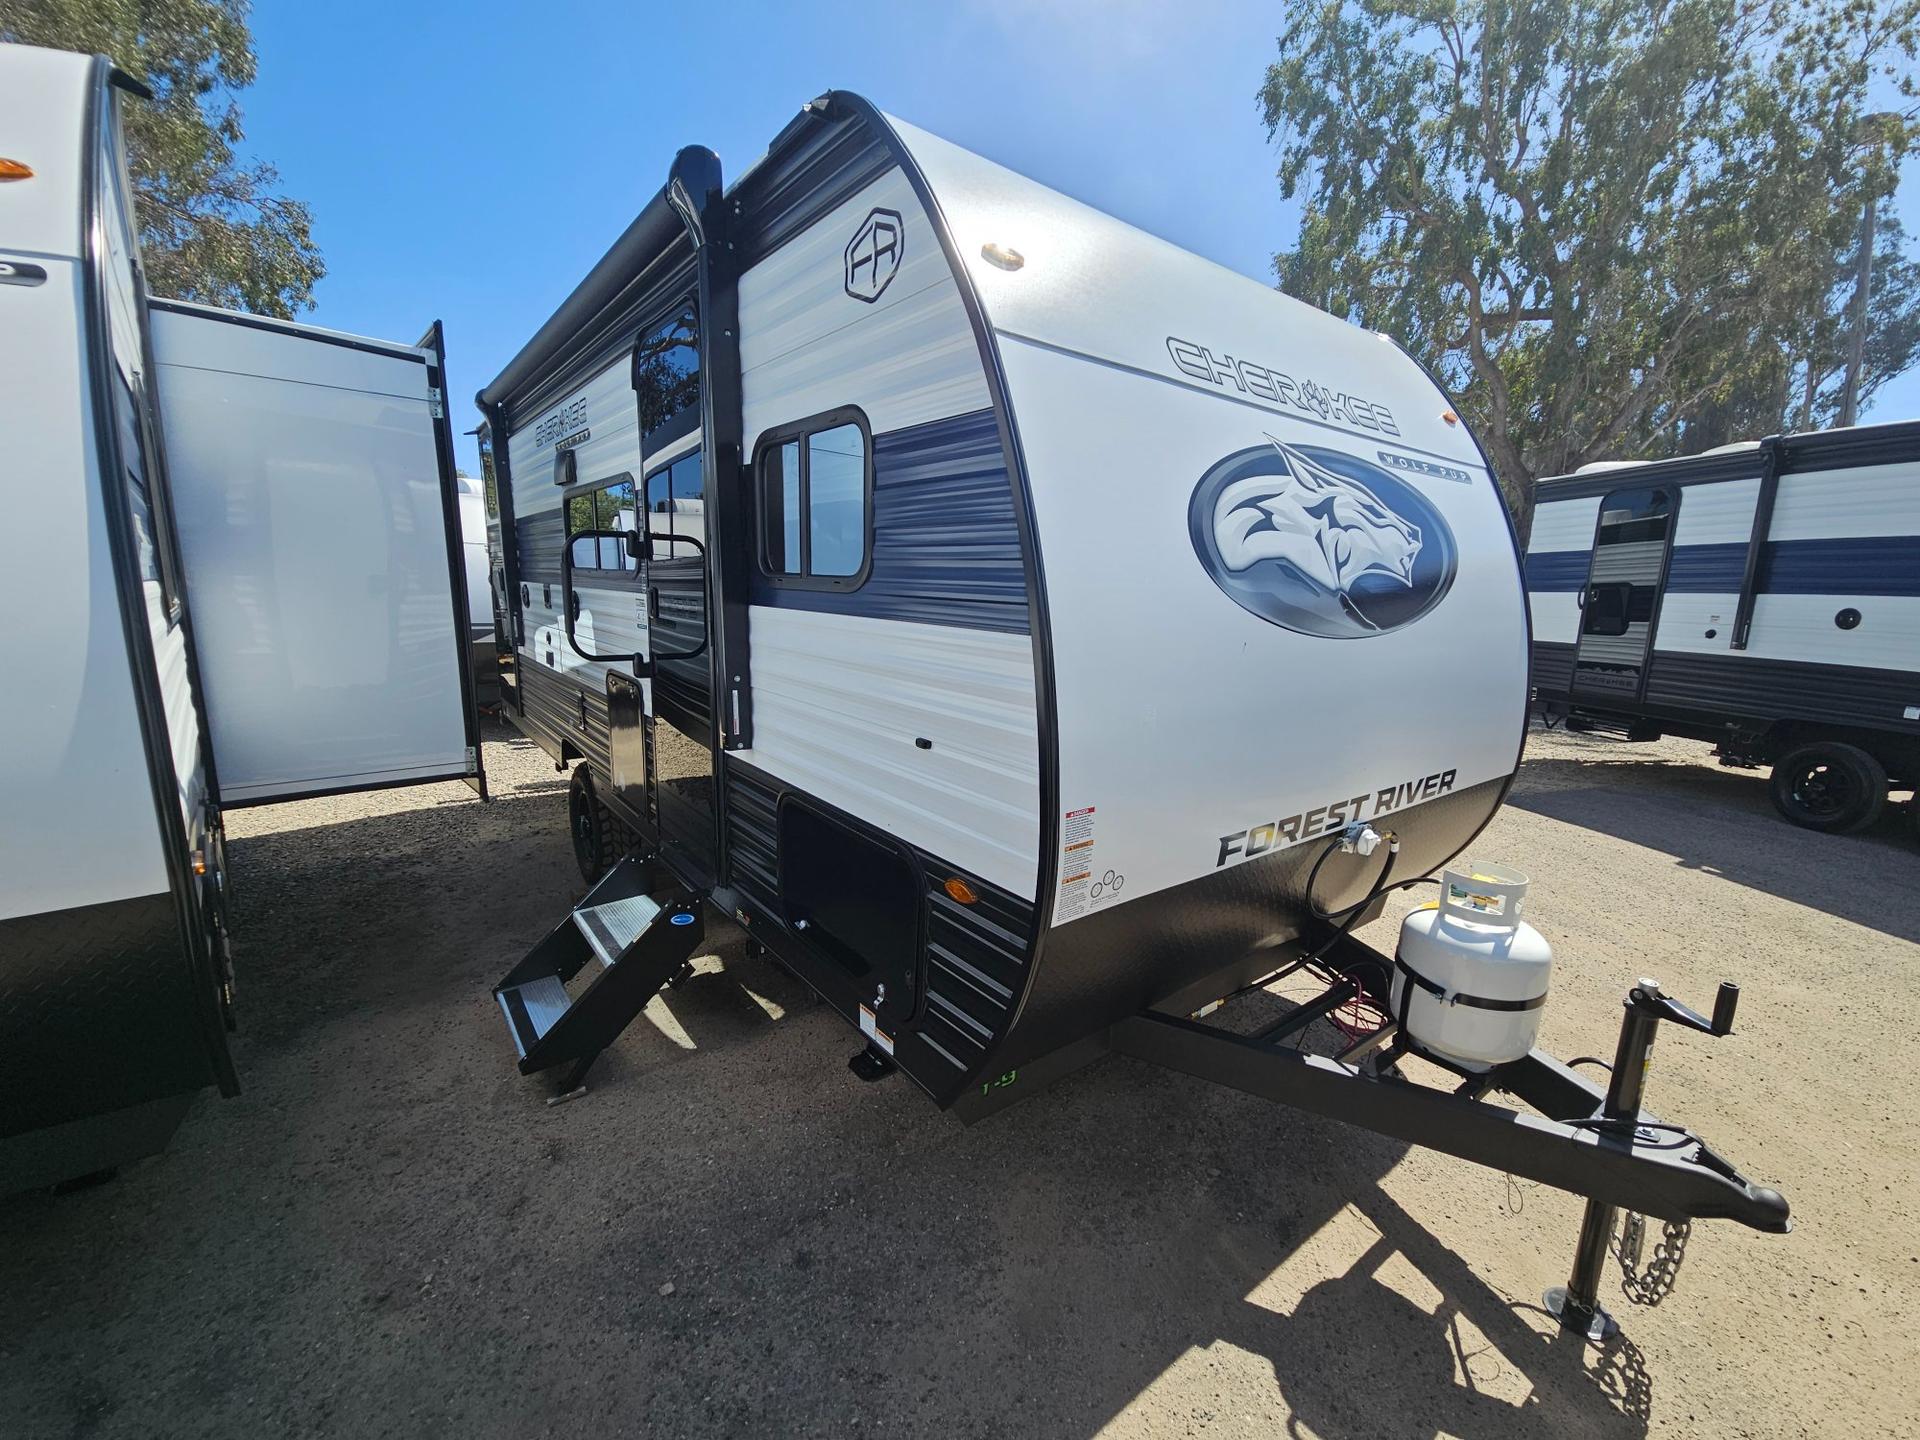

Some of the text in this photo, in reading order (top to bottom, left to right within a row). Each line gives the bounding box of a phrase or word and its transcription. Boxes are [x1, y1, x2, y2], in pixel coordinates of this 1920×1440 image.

[1383, 454, 1467, 481] WOLF PUP
[1216, 768, 1457, 867] FOREST RIVER
